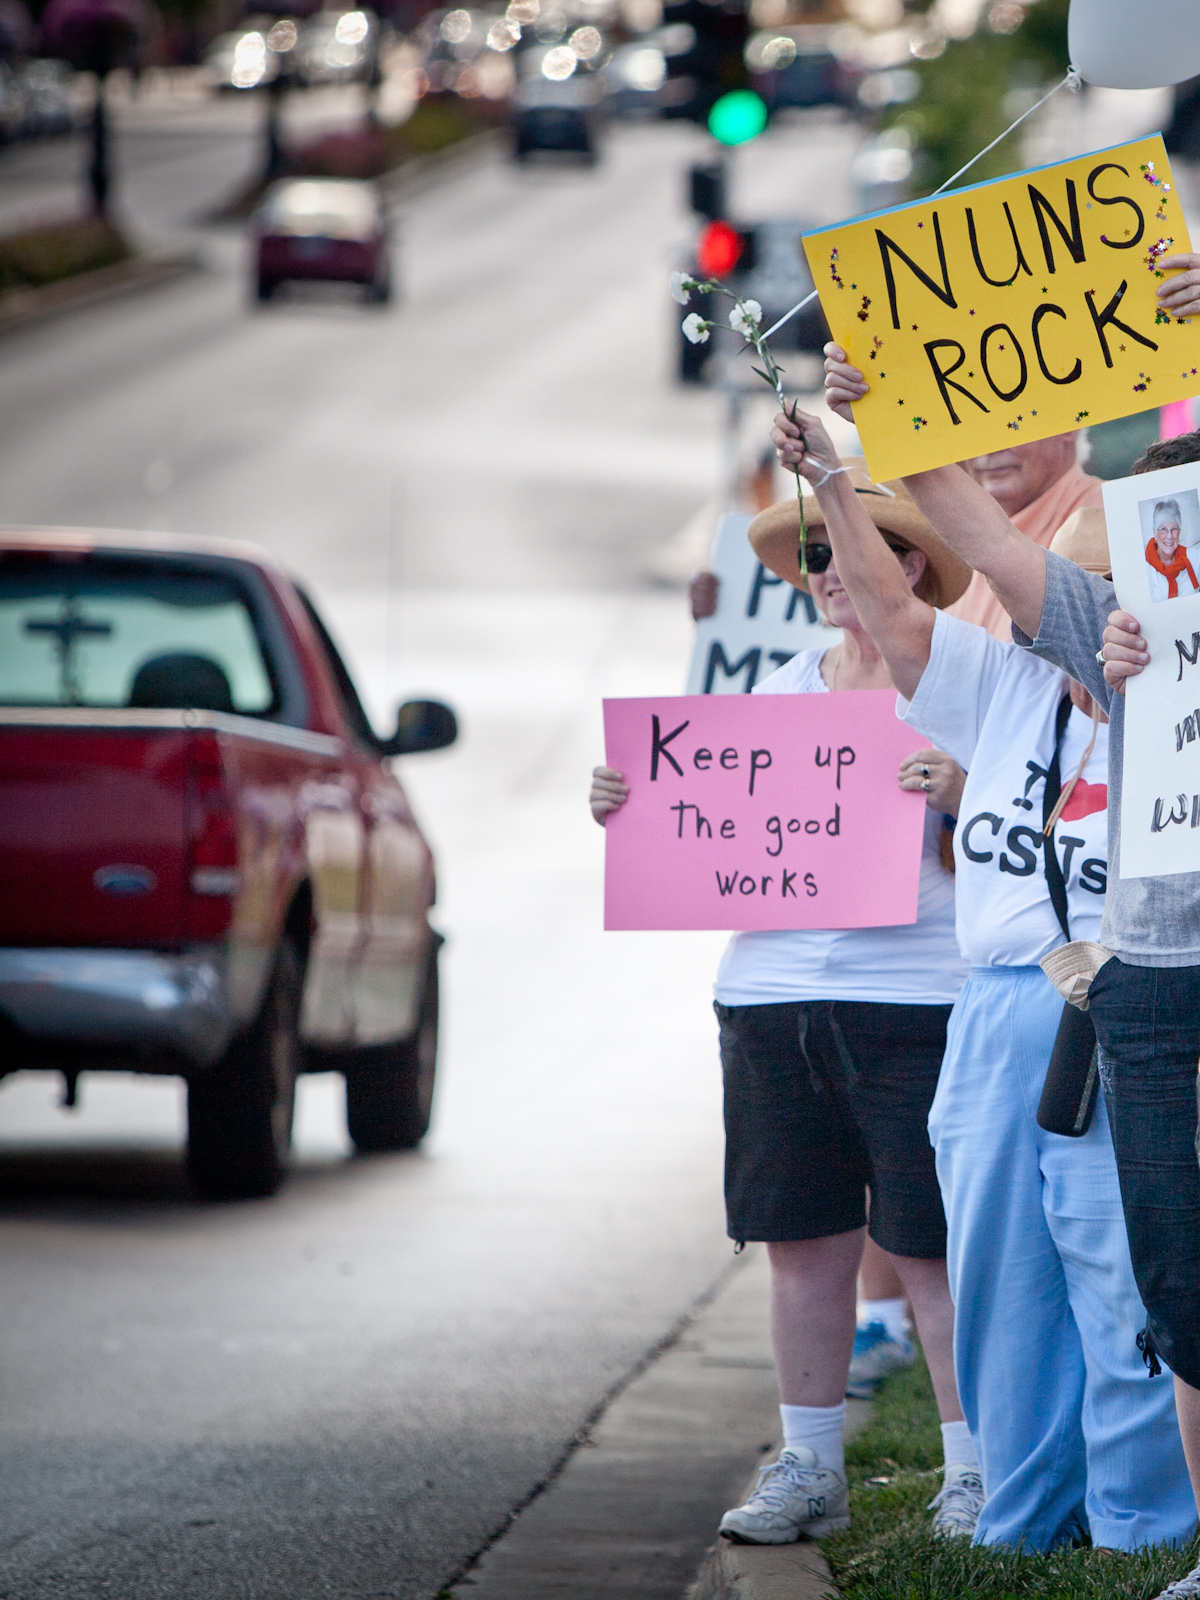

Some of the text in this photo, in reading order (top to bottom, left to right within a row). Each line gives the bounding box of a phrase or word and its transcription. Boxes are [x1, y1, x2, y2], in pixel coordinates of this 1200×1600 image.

[874, 163, 1145, 330] NUNS
[923, 280, 1158, 426] ROCK
[650, 714, 856, 796] Keep up
[766, 803, 841, 857] good
